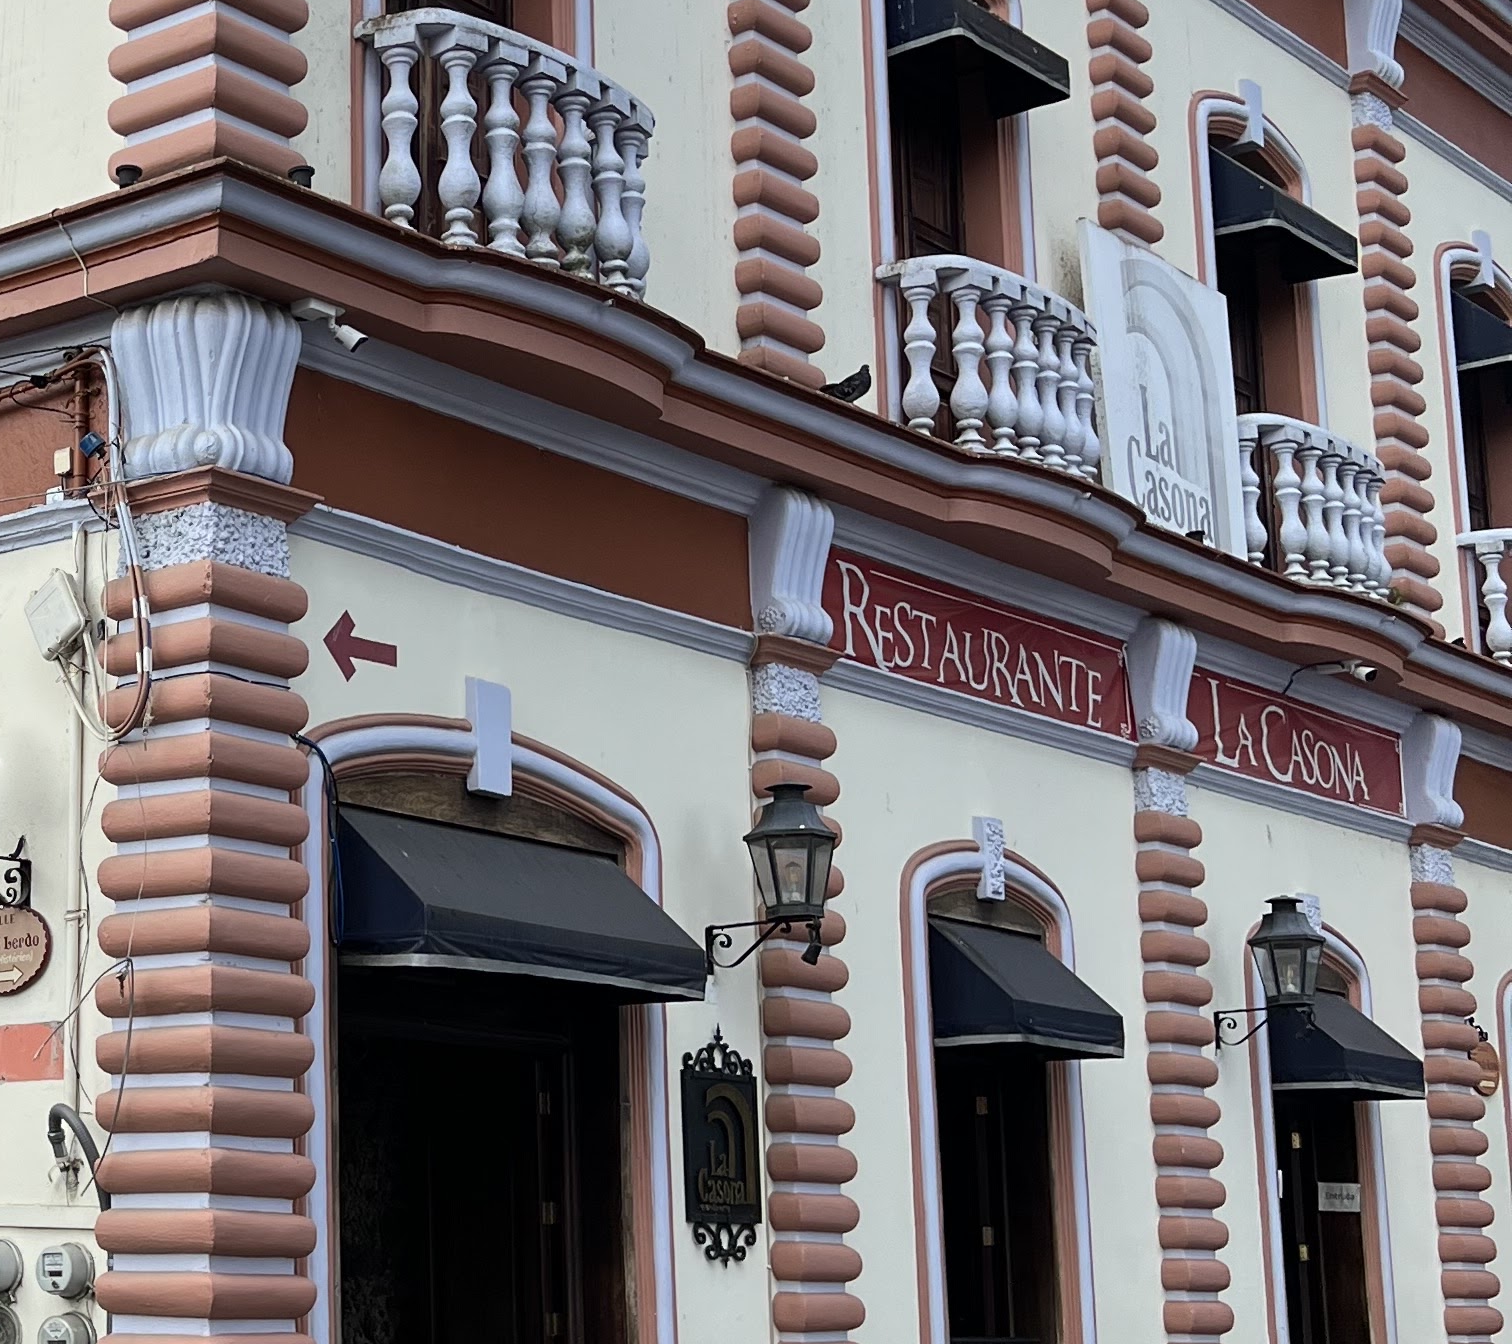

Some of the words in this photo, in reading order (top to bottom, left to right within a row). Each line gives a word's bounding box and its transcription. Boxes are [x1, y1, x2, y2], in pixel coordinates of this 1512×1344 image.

[1138, 383, 1175, 471] La
[1126, 434, 1214, 544] Casona
[835, 558, 1103, 729] RESTAURANTE
[1206, 677, 1259, 769] LA
[1260, 705, 1371, 802] CASONA
[3, 932, 40, 951] Lerdo
[698, 1167, 745, 1205] Casona
[709, 1140, 729, 1177] La
